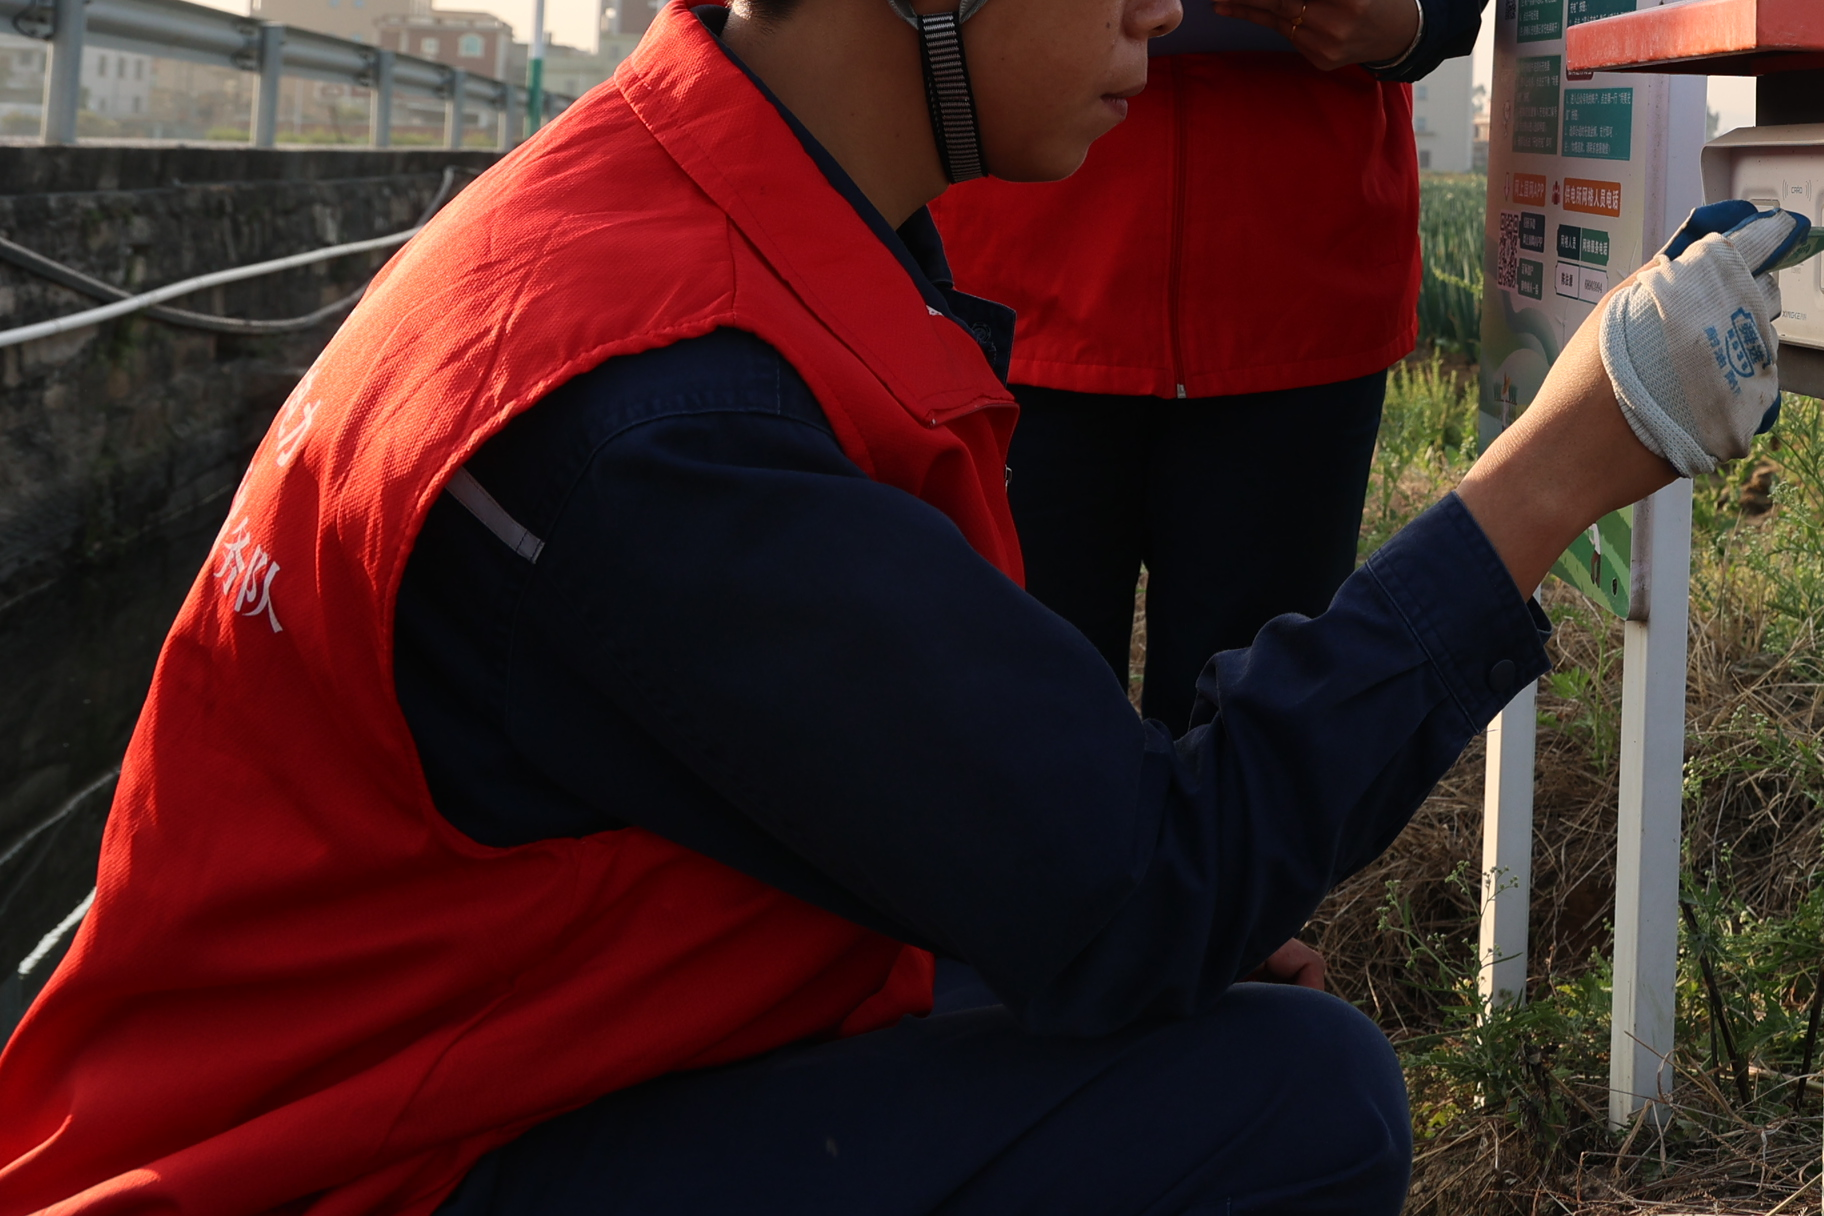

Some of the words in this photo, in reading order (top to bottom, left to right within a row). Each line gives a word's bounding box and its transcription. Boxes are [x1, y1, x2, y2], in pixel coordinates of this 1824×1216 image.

[1564, 184, 1619, 210] 供电所网格人员电话
